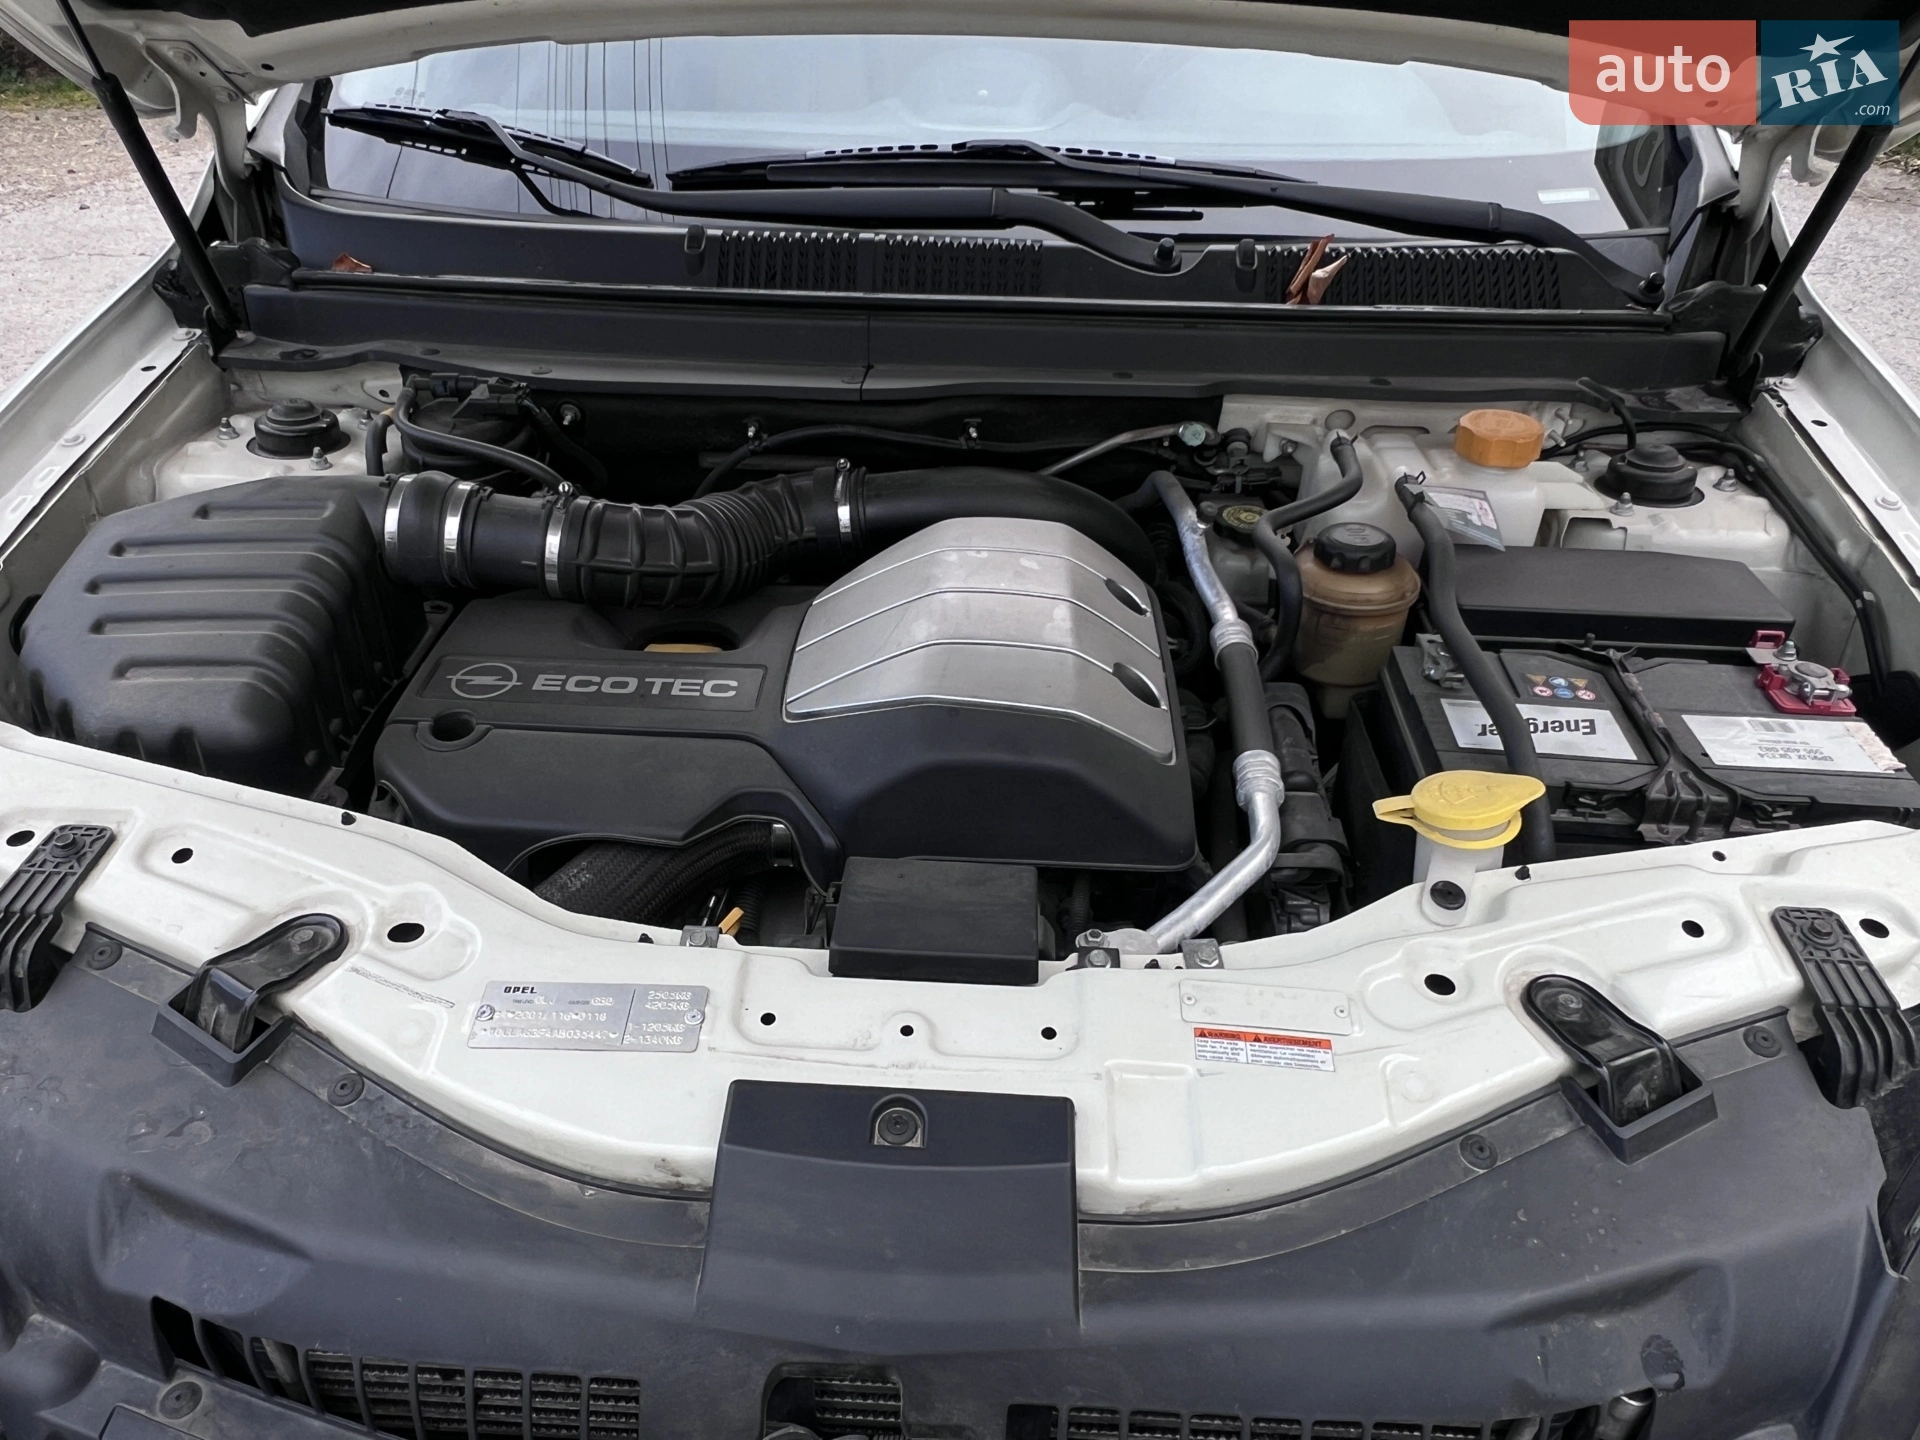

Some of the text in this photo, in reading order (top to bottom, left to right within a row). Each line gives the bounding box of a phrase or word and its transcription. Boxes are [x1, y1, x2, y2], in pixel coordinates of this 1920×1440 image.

[532, 674, 739, 698] ECOTEC
[1477, 717, 1597, 736] Energer
[503, 986, 537, 994] OPEL
